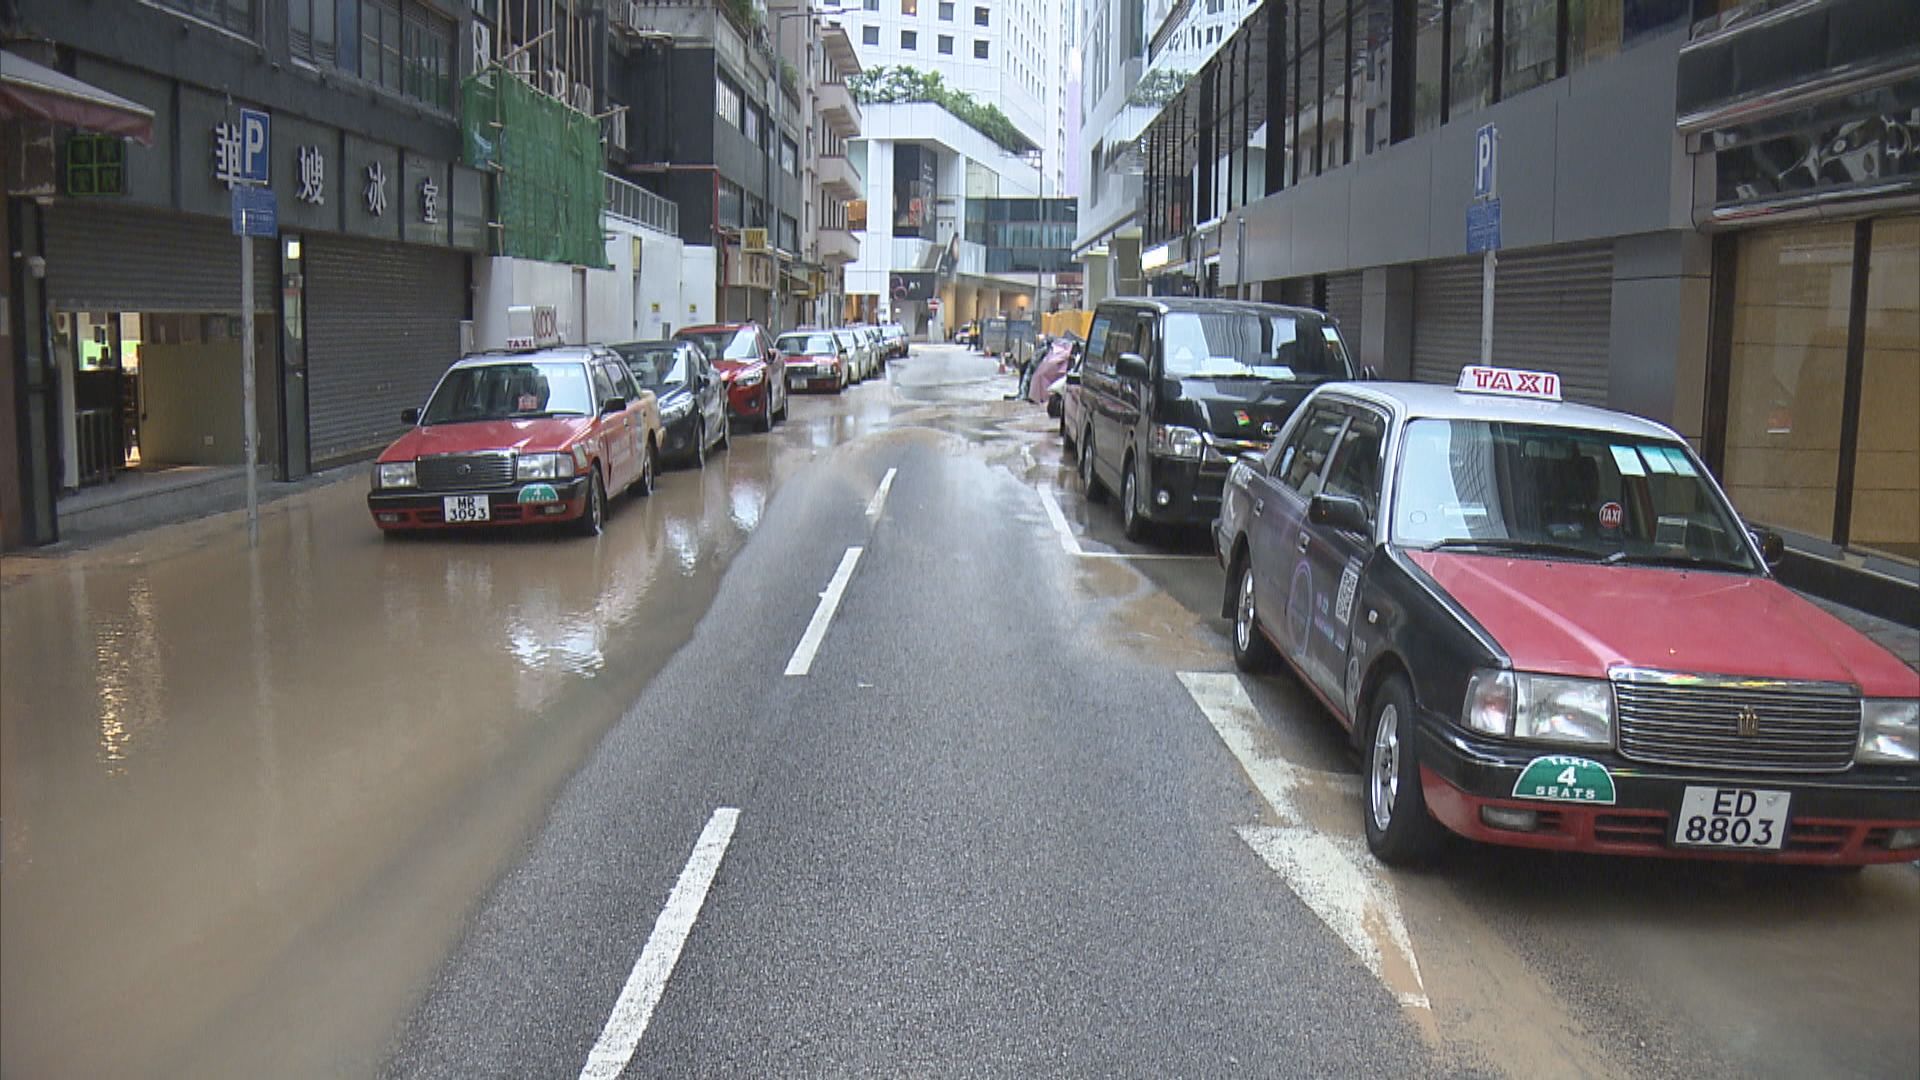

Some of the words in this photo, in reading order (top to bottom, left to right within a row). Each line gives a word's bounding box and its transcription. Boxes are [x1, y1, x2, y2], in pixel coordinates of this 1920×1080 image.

[246, 118, 264, 173] P
[1478, 133, 1490, 190] P
[507, 339, 532, 348] TAXI
[1473, 369, 1555, 395] TAXI
[450, 508, 486, 520] 3093
[1602, 509, 1620, 524] TAXI
[1557, 766, 1577, 787] 4
[1536, 786, 1595, 799] SEATS
[1712, 789, 1757, 817] ED
[1685, 816, 1774, 845] 8803
